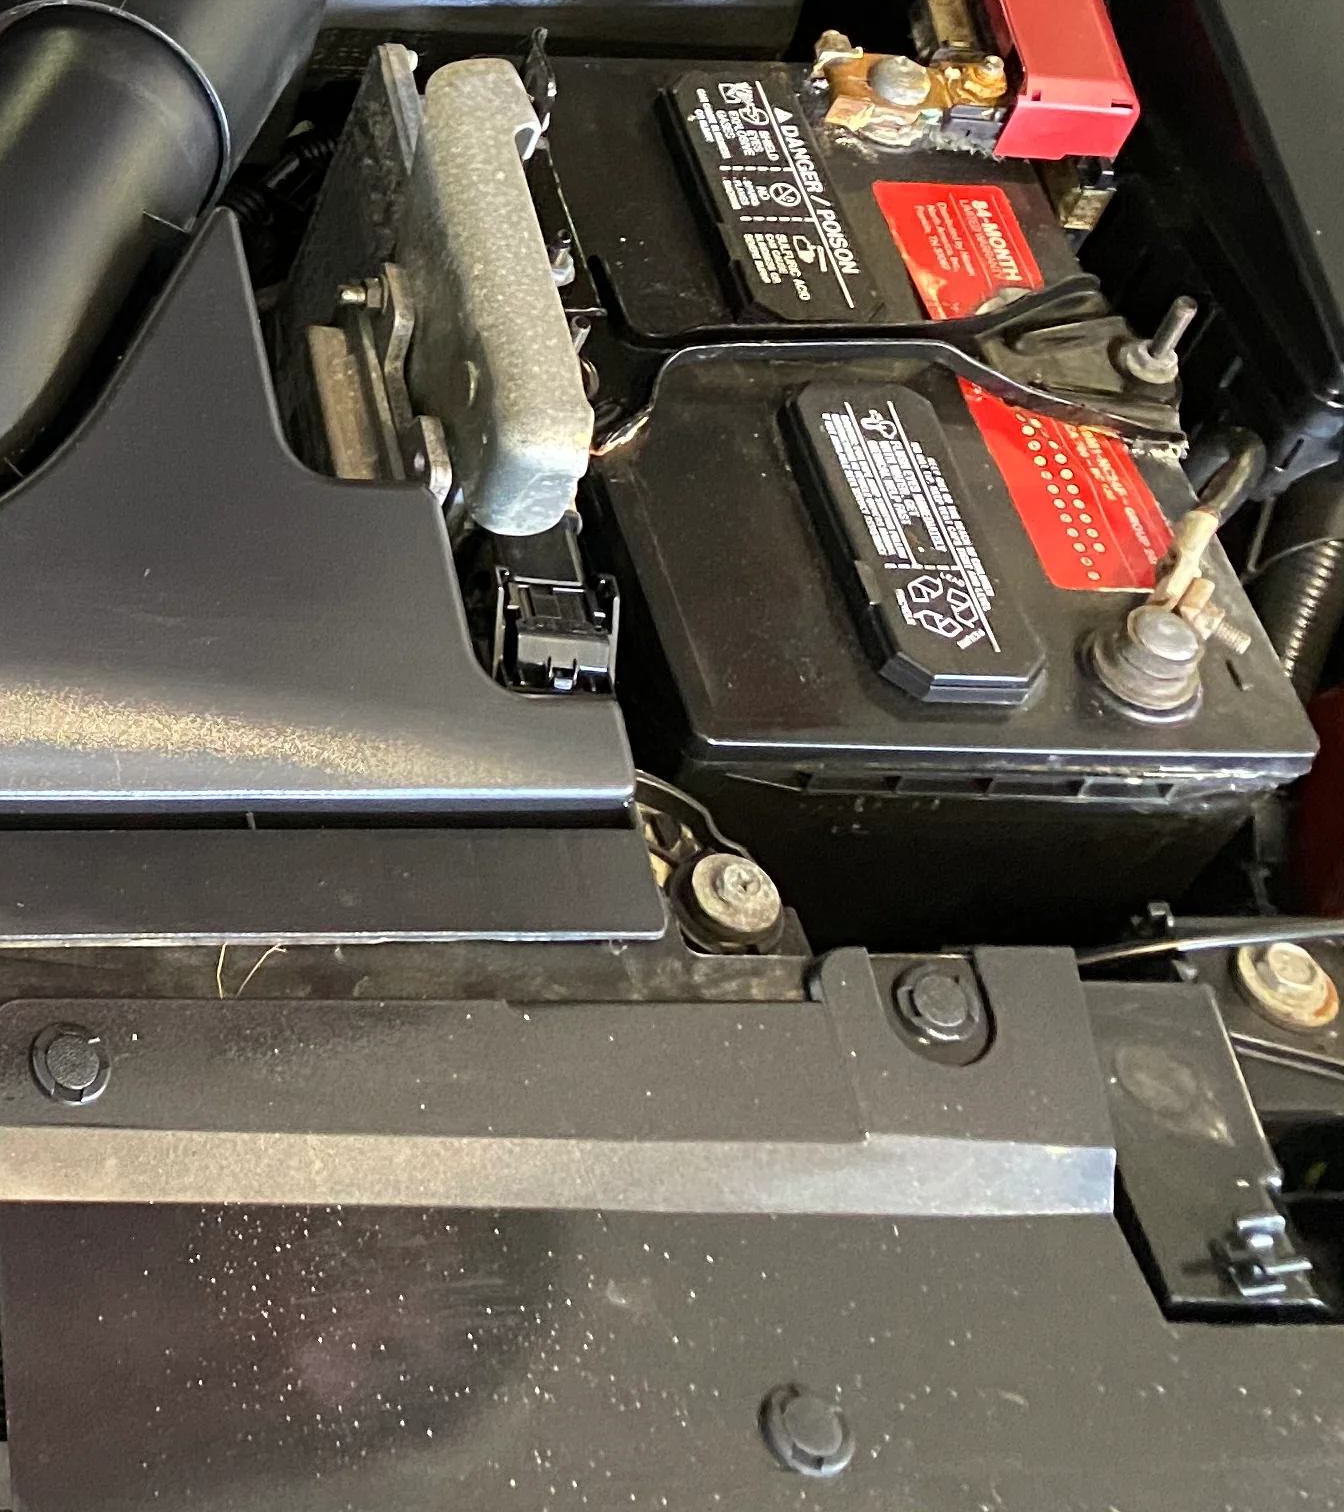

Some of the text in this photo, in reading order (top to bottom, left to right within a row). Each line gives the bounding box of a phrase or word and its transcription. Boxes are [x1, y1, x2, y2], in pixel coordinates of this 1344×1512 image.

[728, 110, 755, 156] EXPLOSIVE
[745, 130, 764, 153] EYES
[758, 130, 780, 161] SHIELD
[755, 185, 771, 201] NO
[780, 125, 861, 274] DANGER / POISON
[971, 199, 1023, 281] 84-MONTH
[774, 233, 811, 301] SULFURIC ACID
[903, 470, 922, 493] EYES
[893, 502, 912, 525] FAST
[903, 498, 921, 518] GET
[1124, 506, 1151, 547] GROUP
